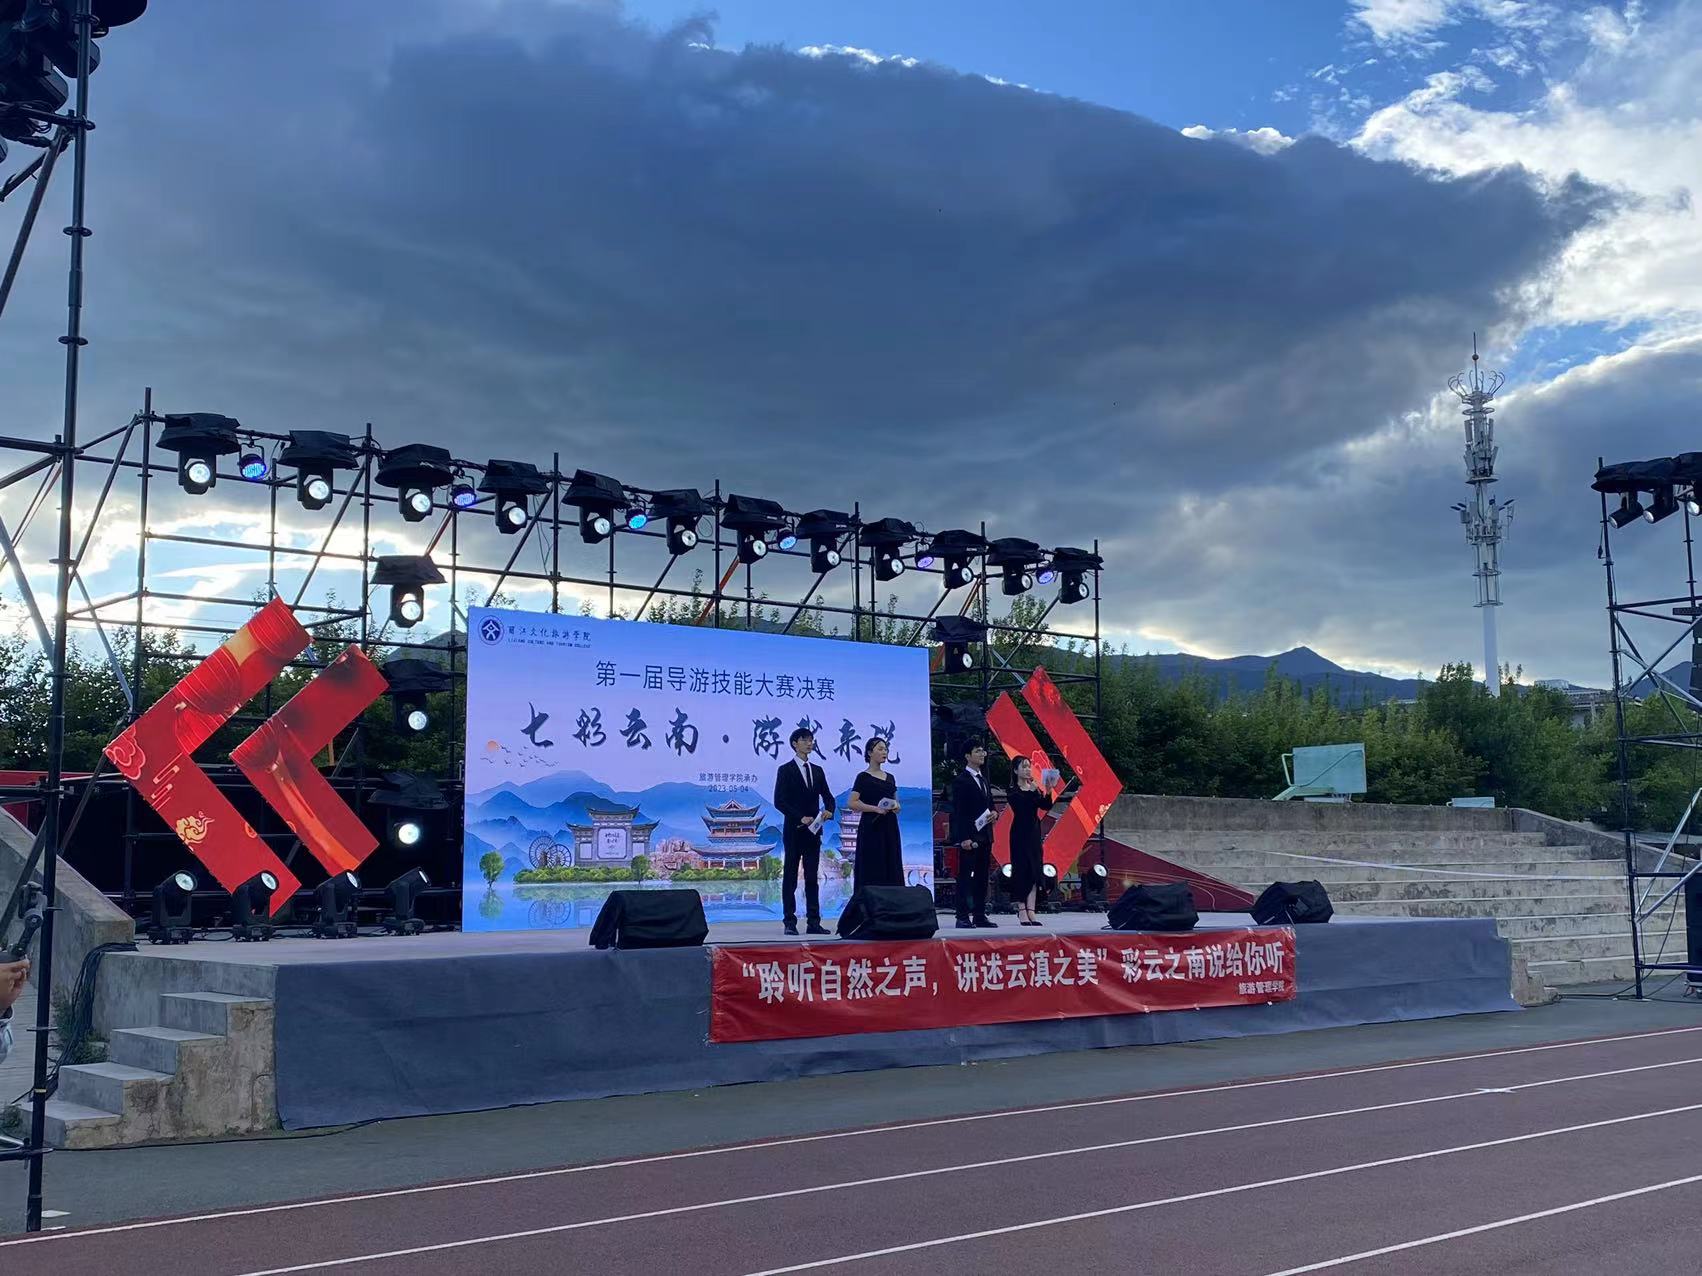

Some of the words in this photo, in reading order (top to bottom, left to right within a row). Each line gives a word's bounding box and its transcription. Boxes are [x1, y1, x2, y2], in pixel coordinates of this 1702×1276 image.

[595, 660, 835, 702] 第一届导游技能大赛决赛
[1238, 979, 1285, 995] 旅游管理学院
